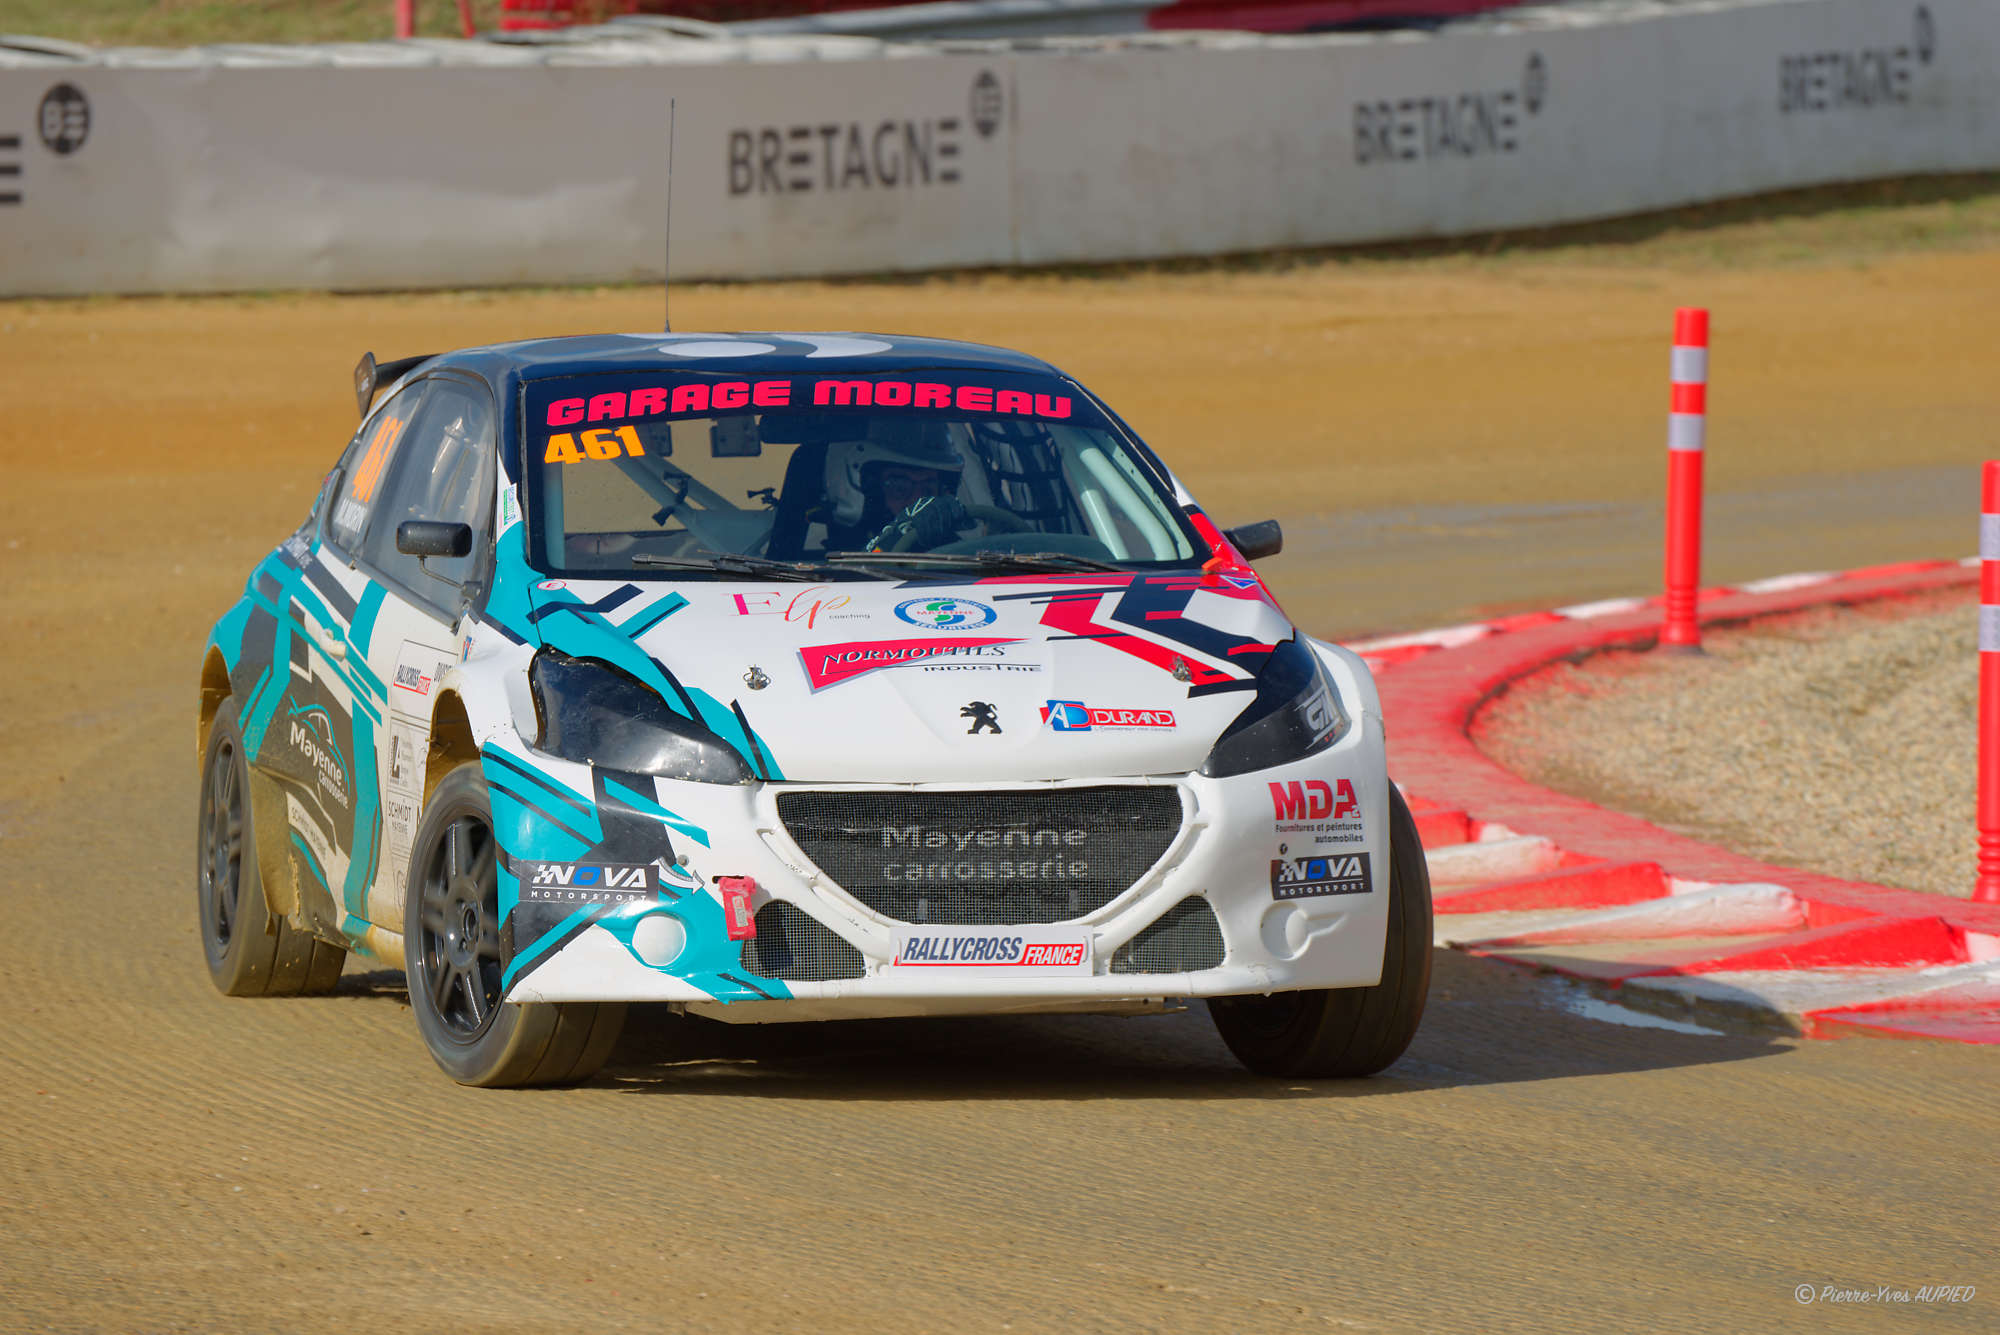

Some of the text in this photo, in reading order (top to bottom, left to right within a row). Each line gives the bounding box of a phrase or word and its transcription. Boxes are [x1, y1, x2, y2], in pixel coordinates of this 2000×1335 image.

[1354, 93, 1516, 164] BRETAGNE
[729, 119, 960, 195] BRETAGNE
[547, 380, 1071, 426] GARAGE MOREAU
[544, 425, 645, 464] 461
[821, 647, 1006, 675] NORMOUTILS
[923, 663, 1042, 673] INDUSTRIE
[1094, 710, 1174, 726] DURAND
[289, 721, 343, 787] Mayenne
[881, 825, 1088, 851] Mayenne
[1275, 822, 1363, 833] Fournitures et peintures
[1315, 833, 1364, 843] automobiles
[533, 865, 647, 887] NOVA
[884, 853, 1088, 880] carrosserie
[1278, 857, 1363, 881] NOVA
[531, 890, 648, 901] MOTORSPORT
[1280, 882, 1364, 897] MOTORSPORT
[903, 937, 1082, 965] RALLYCROSS FRANCE
